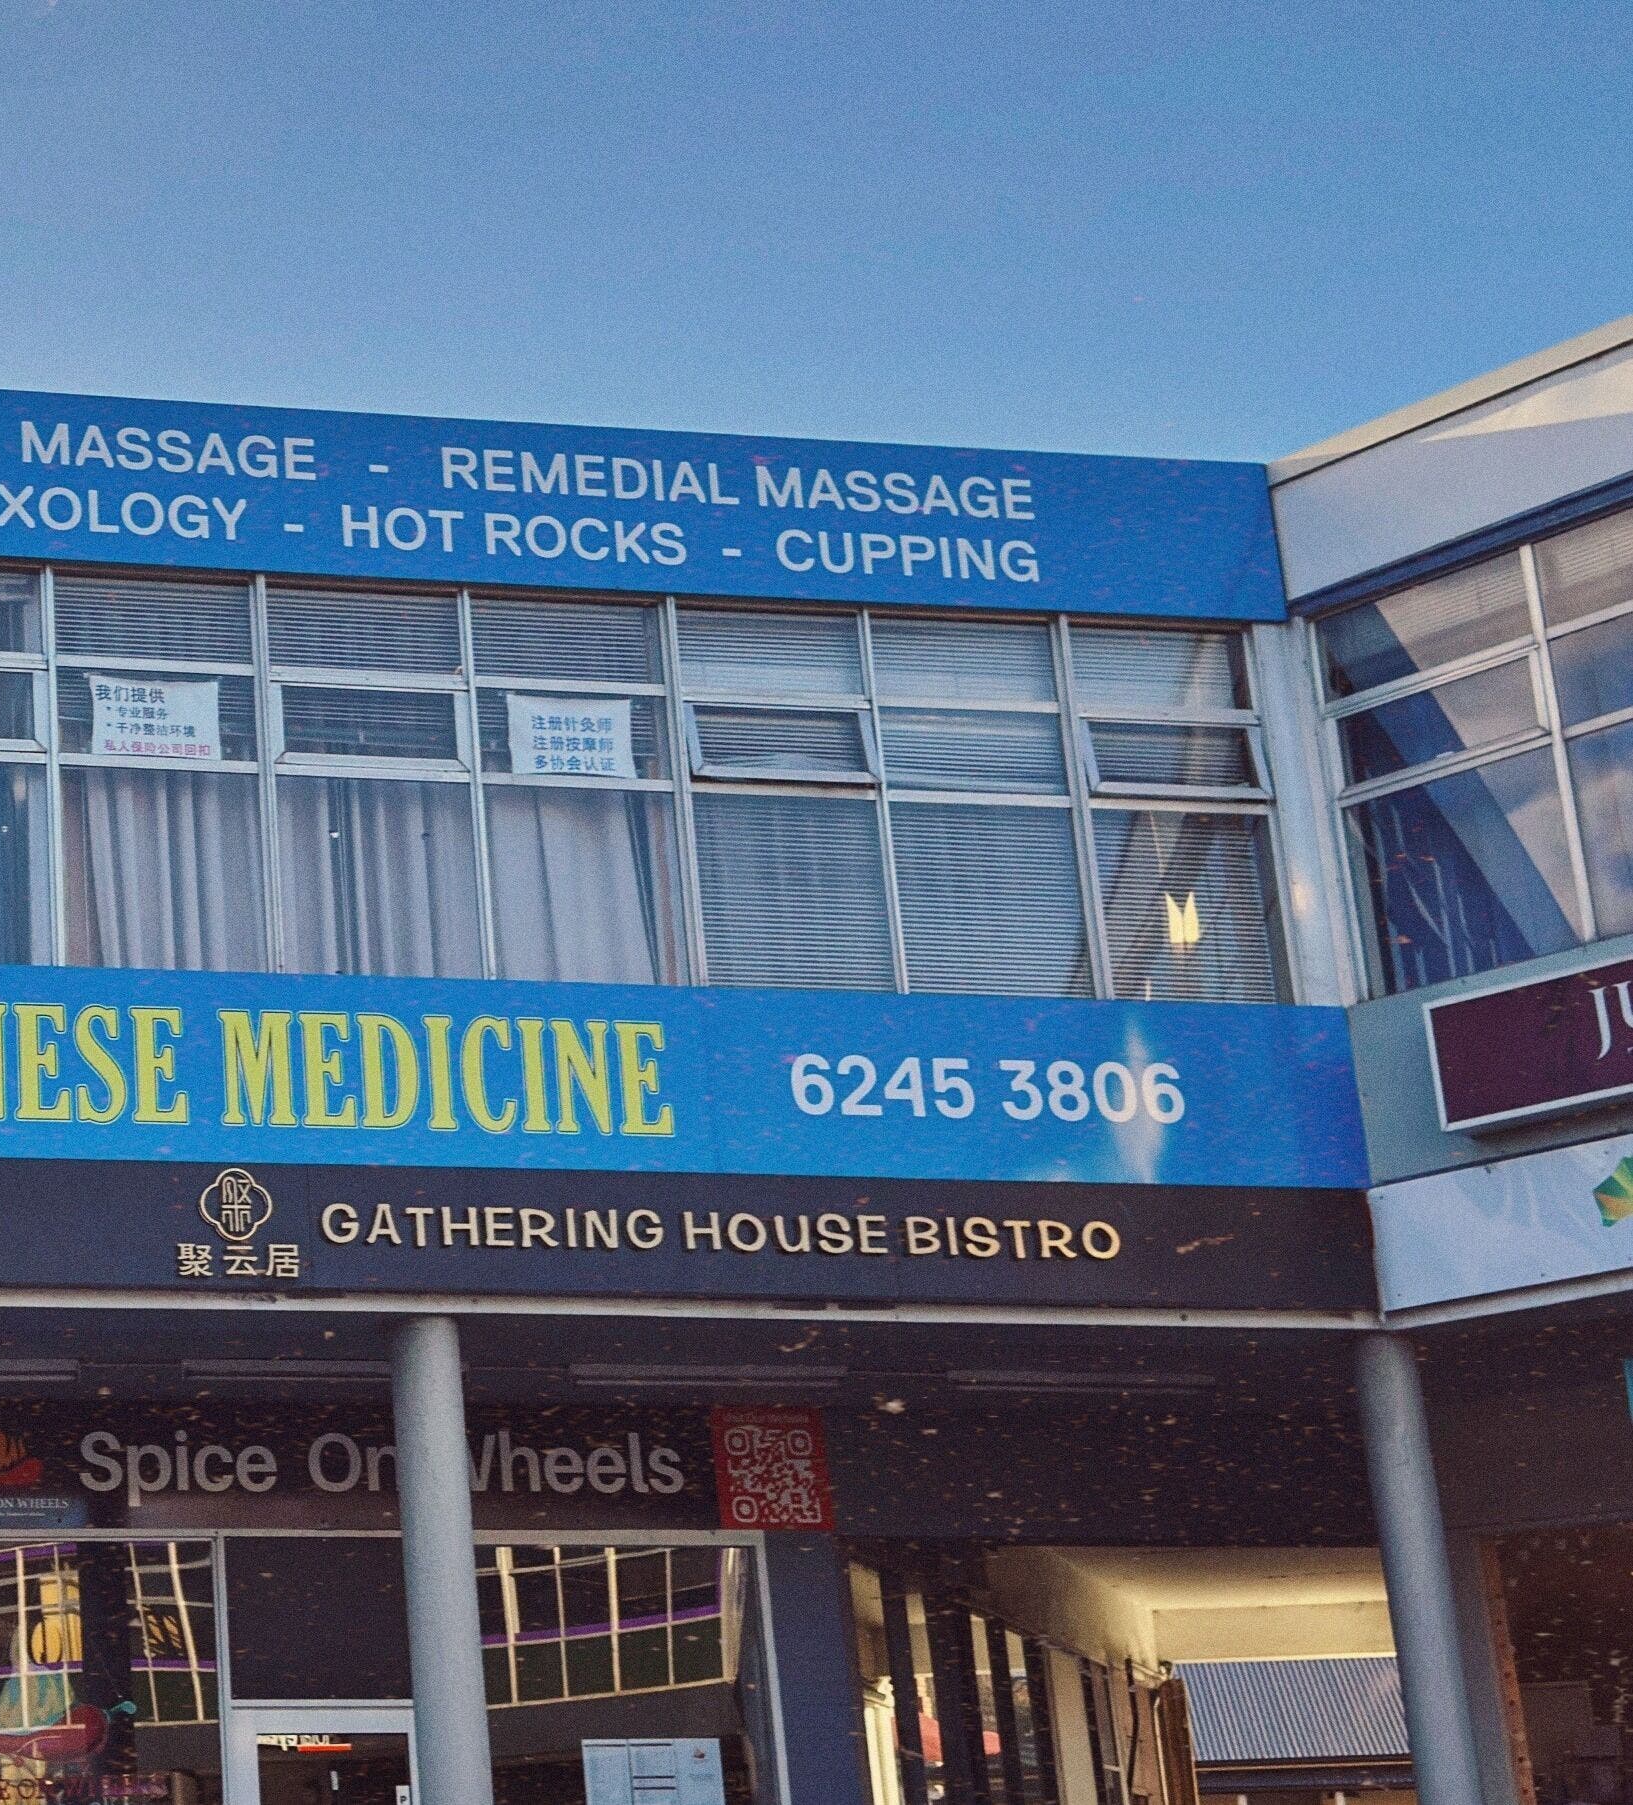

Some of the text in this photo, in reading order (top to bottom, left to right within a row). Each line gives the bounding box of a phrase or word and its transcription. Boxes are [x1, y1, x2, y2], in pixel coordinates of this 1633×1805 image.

[22, 420, 317, 481] MASSAGE
[441, 446, 740, 505] REMEDIAL
[756, 464, 1035, 521] MASSAGE
[341, 504, 464, 553] HOT
[485, 512, 688, 566] ROCKS
[776, 528, 1041, 583] CUPPING
[95, 684, 165, 703] 我们提供
[117, 706, 168, 720] 专业服务
[531, 715, 613, 733] 注册针灸师
[533, 735, 614, 755] 注册按摩师
[534, 755, 617, 771] 多协会认证
[218, 1005, 676, 1139] MEDICINE
[789, 1052, 1187, 1127] 6245 3806
[320, 1201, 1123, 1262] GATHERING HOUSE BISTRO
[177, 1243, 300, 1278] 聚云居
[79, 1429, 278, 1508] Spice
[307, 1433, 399, 1493] On
